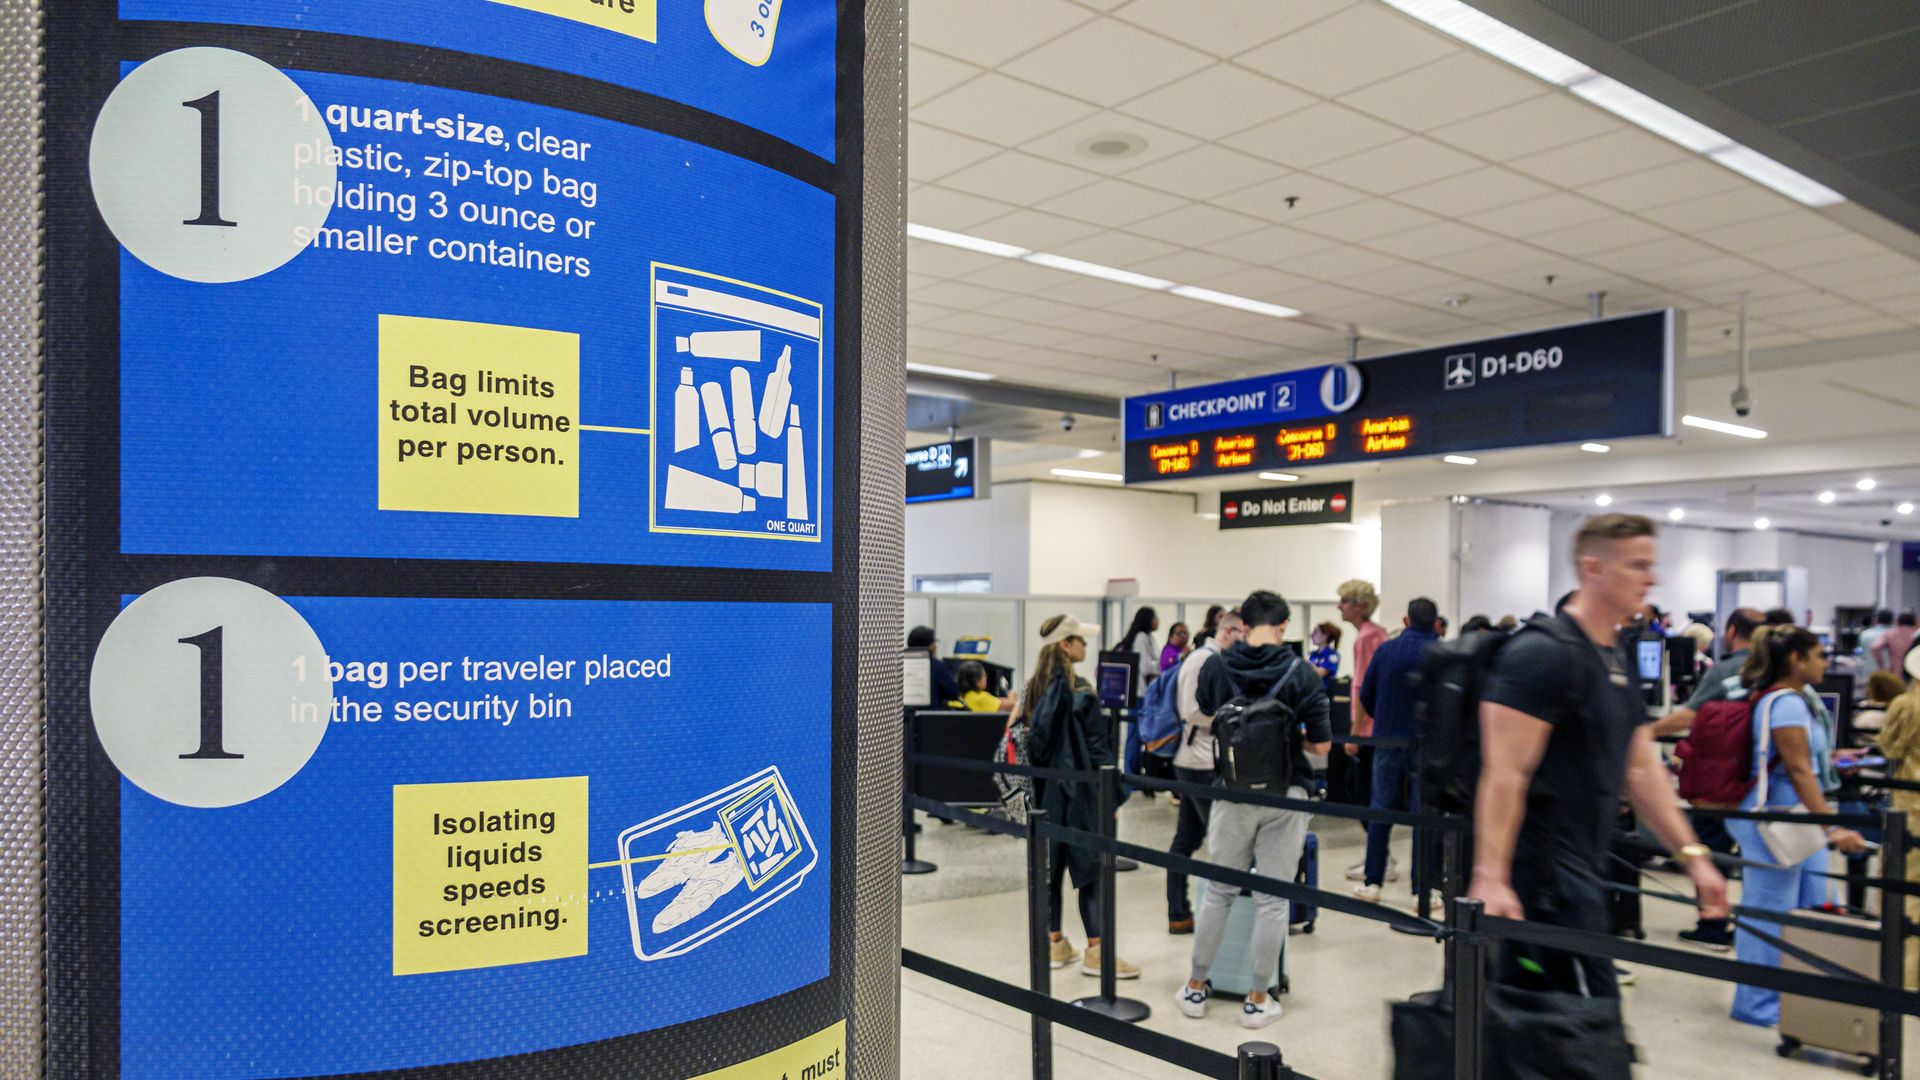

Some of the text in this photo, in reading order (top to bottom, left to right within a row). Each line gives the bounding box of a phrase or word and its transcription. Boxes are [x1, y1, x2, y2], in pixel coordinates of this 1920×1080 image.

[295, 95, 592, 161] 1 quart-size, clear
[182, 89, 238, 227] 1
[294, 137, 598, 208] plastic, zip-top bag
[294, 178, 596, 239] holding 3 ounce or
[293, 224, 592, 278] smaller containers
[1481, 346, 1563, 378] D1-D60
[409, 364, 555, 398] Bag limits
[389, 399, 570, 432] total volume
[1169, 385, 1291, 421] CHECKPOINT 2
[398, 437, 564, 465] per person.
[1241, 497, 1325, 517] Do Not Enter
[766, 519, 815, 534] ONE QUART
[290, 653, 672, 689] 1 bag per traveler placed
[178, 625, 245, 759] 1
[290, 693, 572, 726] in the security bin
[433, 808, 556, 835] Isolating
[447, 841, 543, 872] liquids
[443, 873, 546, 906] speeds
[418, 906, 568, 937] screening.
[801, 1047, 840, 1080] must
